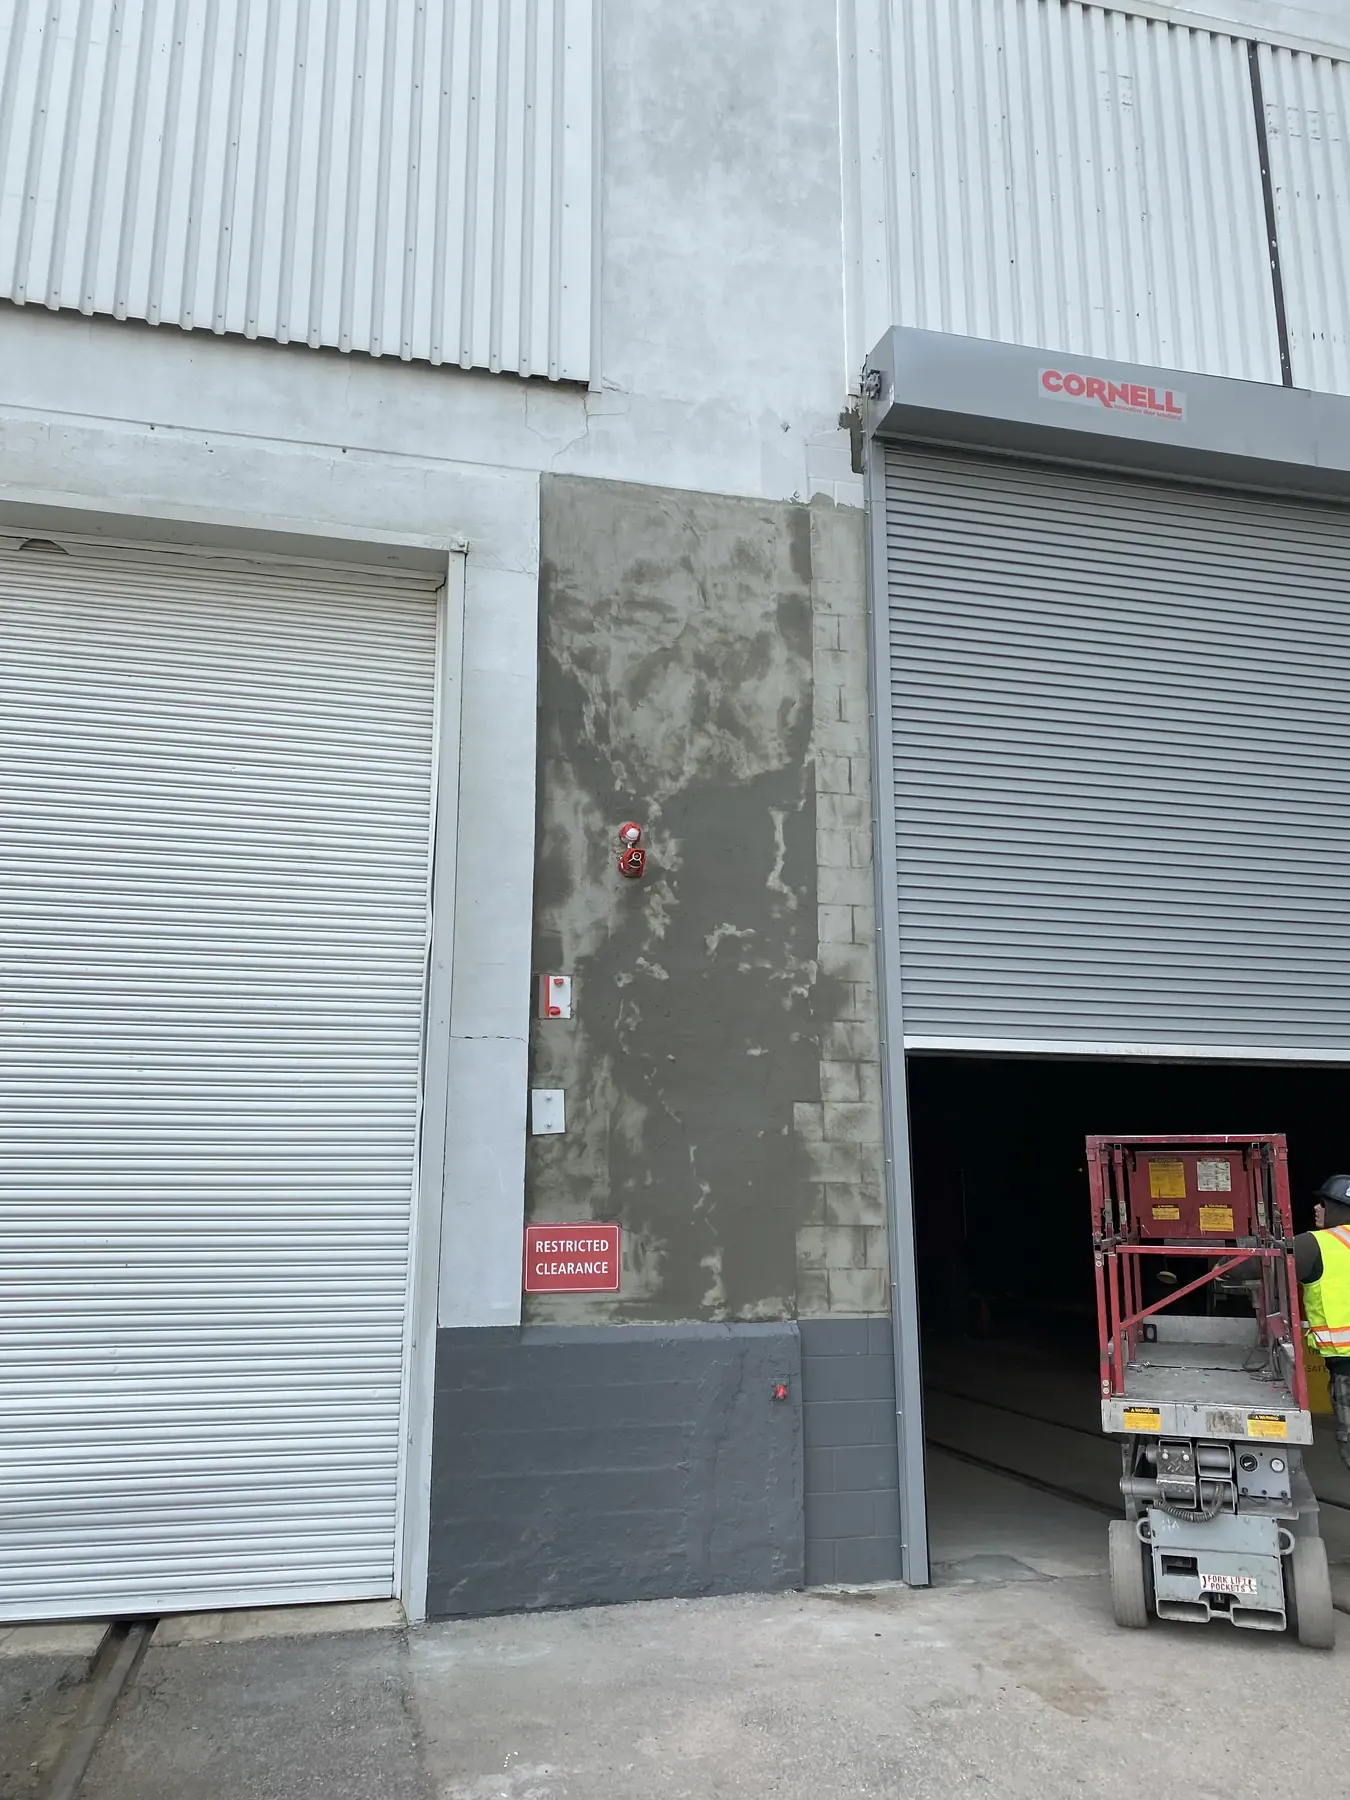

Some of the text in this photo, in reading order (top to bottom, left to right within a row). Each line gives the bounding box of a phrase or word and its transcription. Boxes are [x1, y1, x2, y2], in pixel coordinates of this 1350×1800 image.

[1042, 370, 1182, 414] CORNELL
[535, 1240, 609, 1252] RESTRICTED
[535, 1262, 609, 1275] CLEARANCE
[1207, 1575, 1247, 1585] FORK LIFT
[1210, 1583, 1246, 1593] POCKETS
